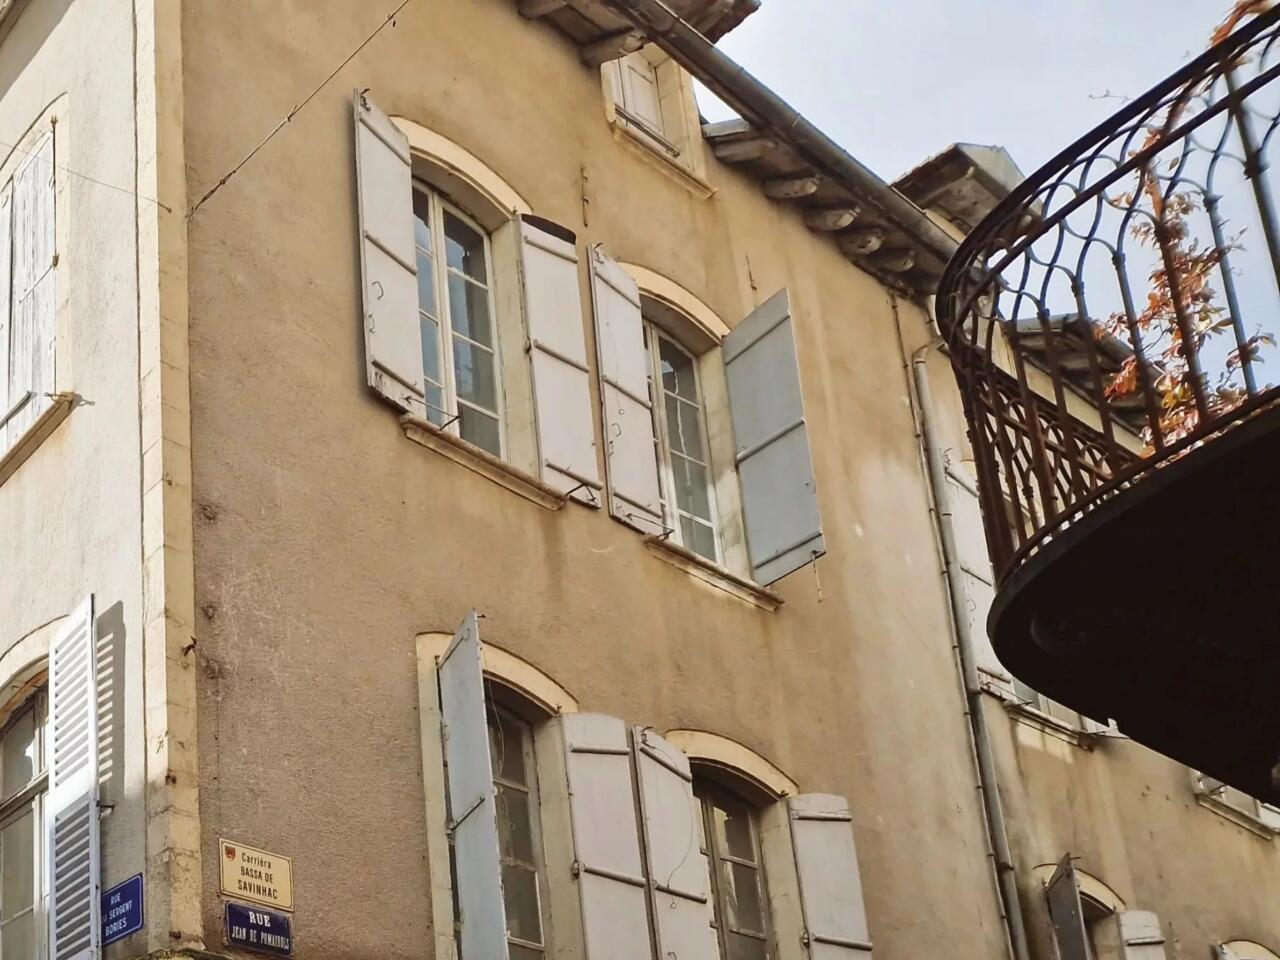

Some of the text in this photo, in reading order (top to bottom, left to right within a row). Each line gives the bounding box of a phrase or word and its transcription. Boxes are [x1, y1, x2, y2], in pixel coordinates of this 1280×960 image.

[241, 866, 273, 883] BASSA DE
[238, 879, 278, 900] SAVINHAC
[111, 892, 120, 905] RUE
[109, 900, 132, 919] SERGENT
[106, 917, 127, 936] BORIES
[249, 911, 271, 927] RUE
[232, 925, 246, 941] JEAN
